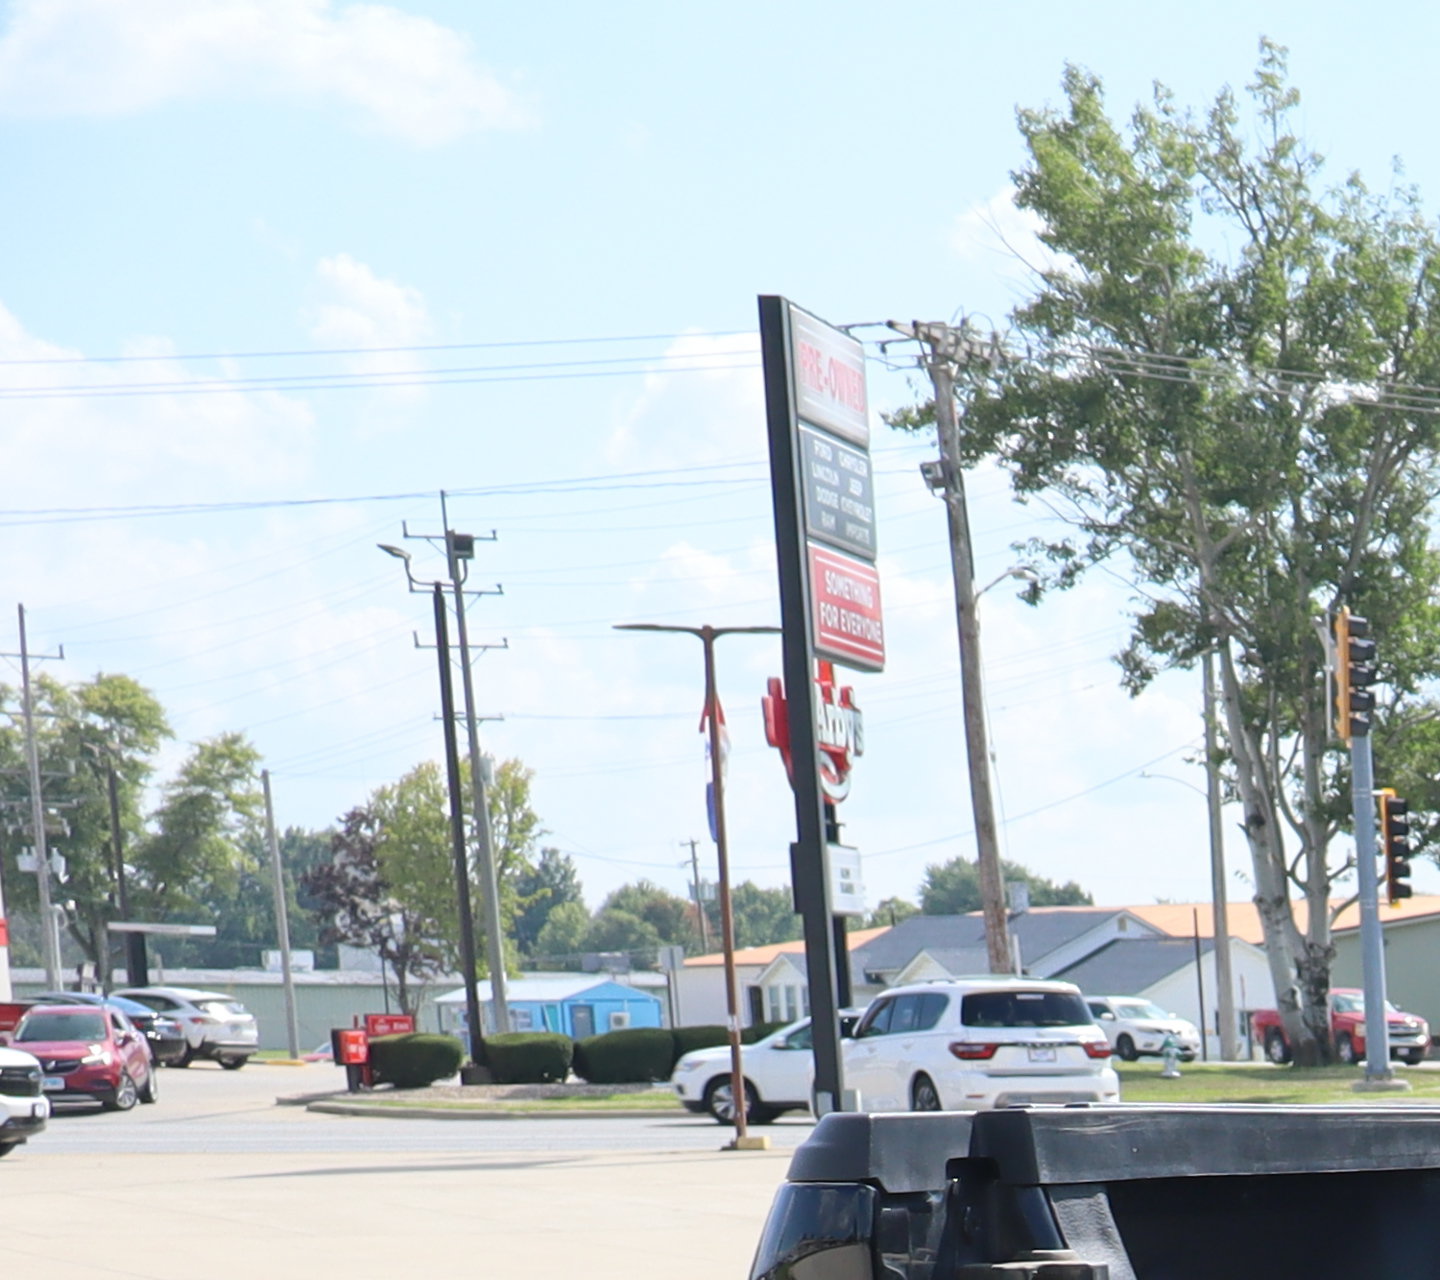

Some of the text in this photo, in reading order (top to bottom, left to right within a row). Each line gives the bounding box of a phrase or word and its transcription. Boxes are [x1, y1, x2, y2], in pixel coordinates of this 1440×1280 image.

[799, 340, 866, 414] PRE-OWNED
[825, 569, 873, 609] SOMETHING
[820, 601, 882, 645] FOR EVERYONE
